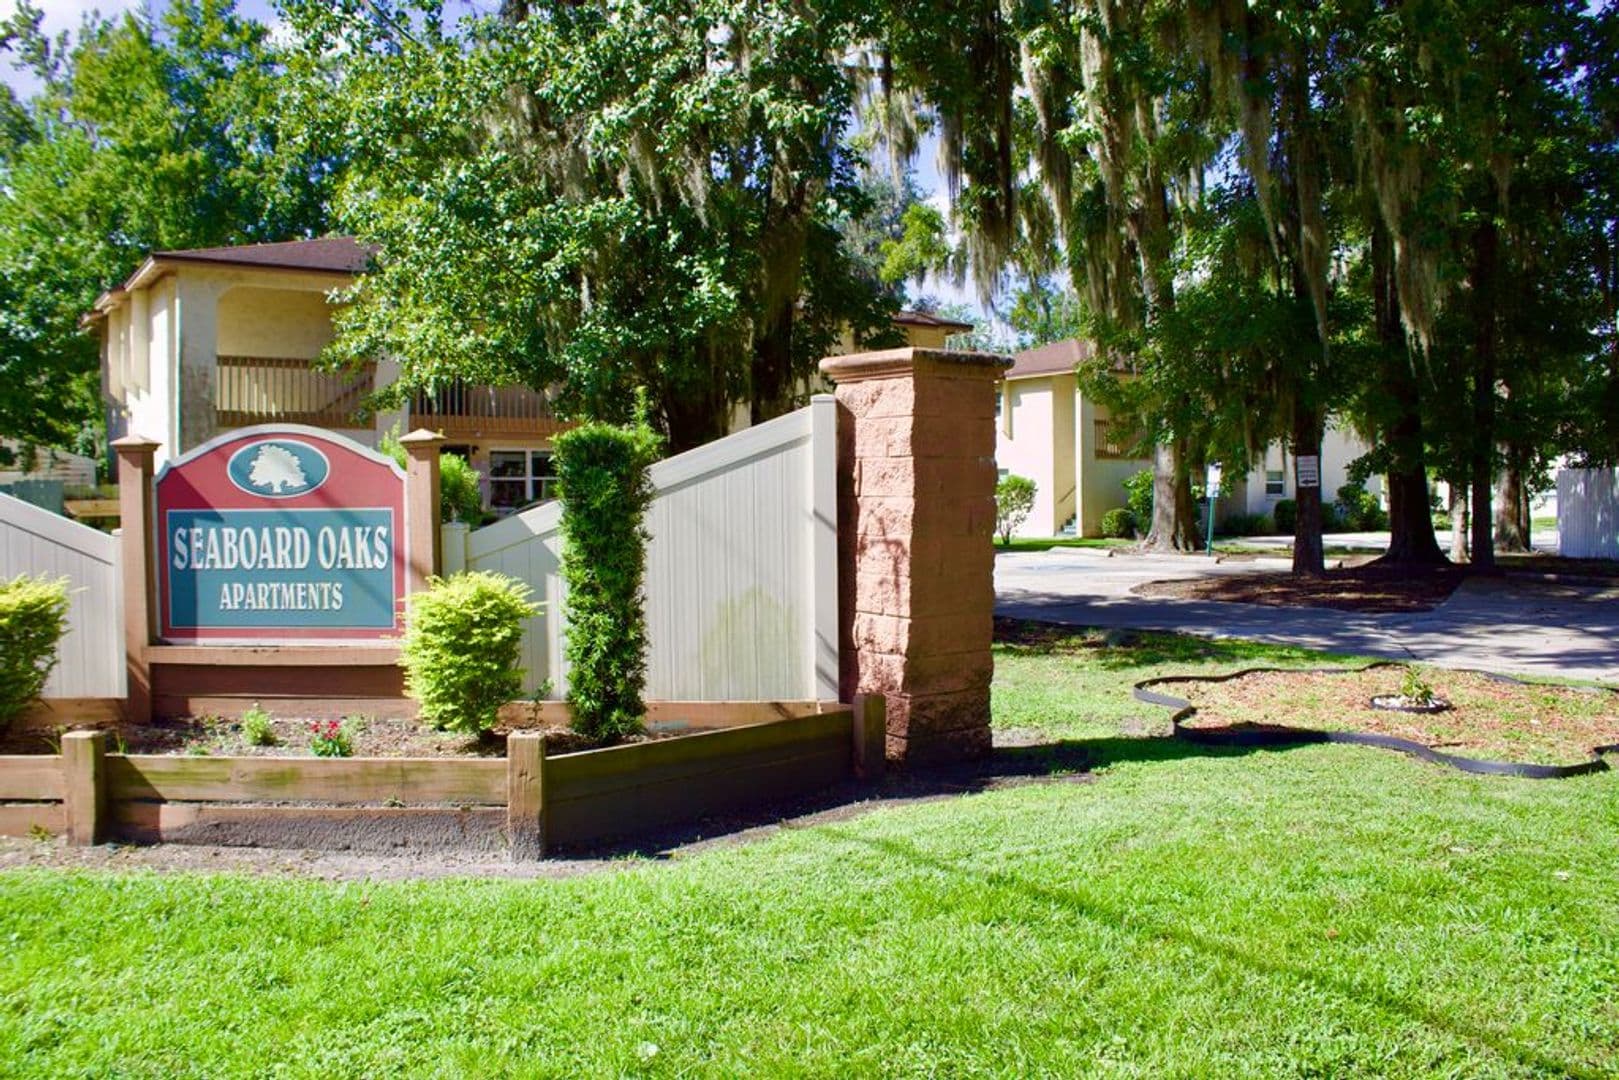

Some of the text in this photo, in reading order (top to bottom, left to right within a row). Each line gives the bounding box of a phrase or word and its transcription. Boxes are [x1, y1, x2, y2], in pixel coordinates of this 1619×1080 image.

[173, 525, 389, 570] SEABOARD OAKS
[219, 582, 343, 610] APARTMENTS
